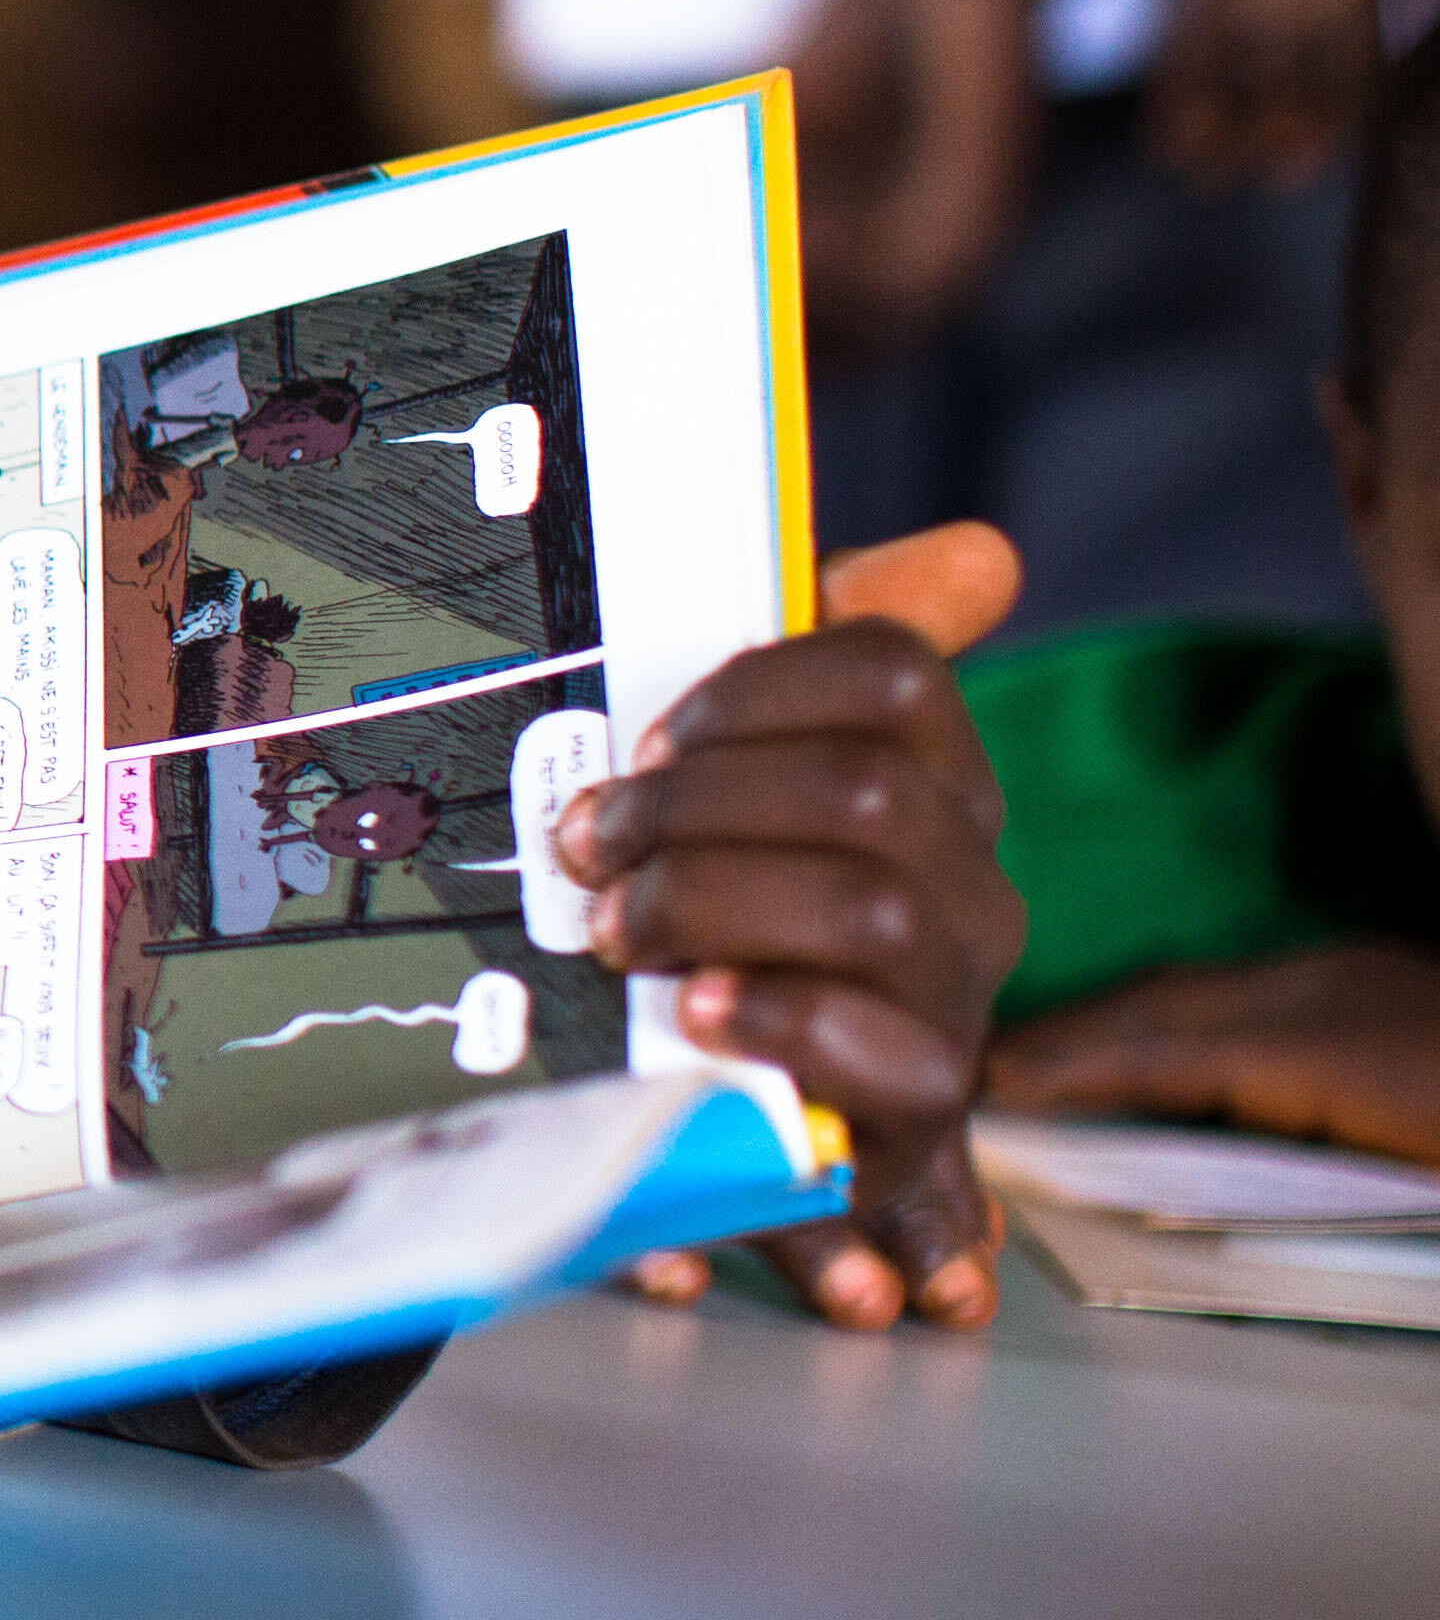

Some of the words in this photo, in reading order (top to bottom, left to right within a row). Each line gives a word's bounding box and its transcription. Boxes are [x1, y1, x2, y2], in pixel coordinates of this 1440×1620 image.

[12, 602, 29, 626] LES
[40, 680, 57, 701] NE
[39, 756, 58, 784] PAS
[118, 792, 139, 835] SALUT
